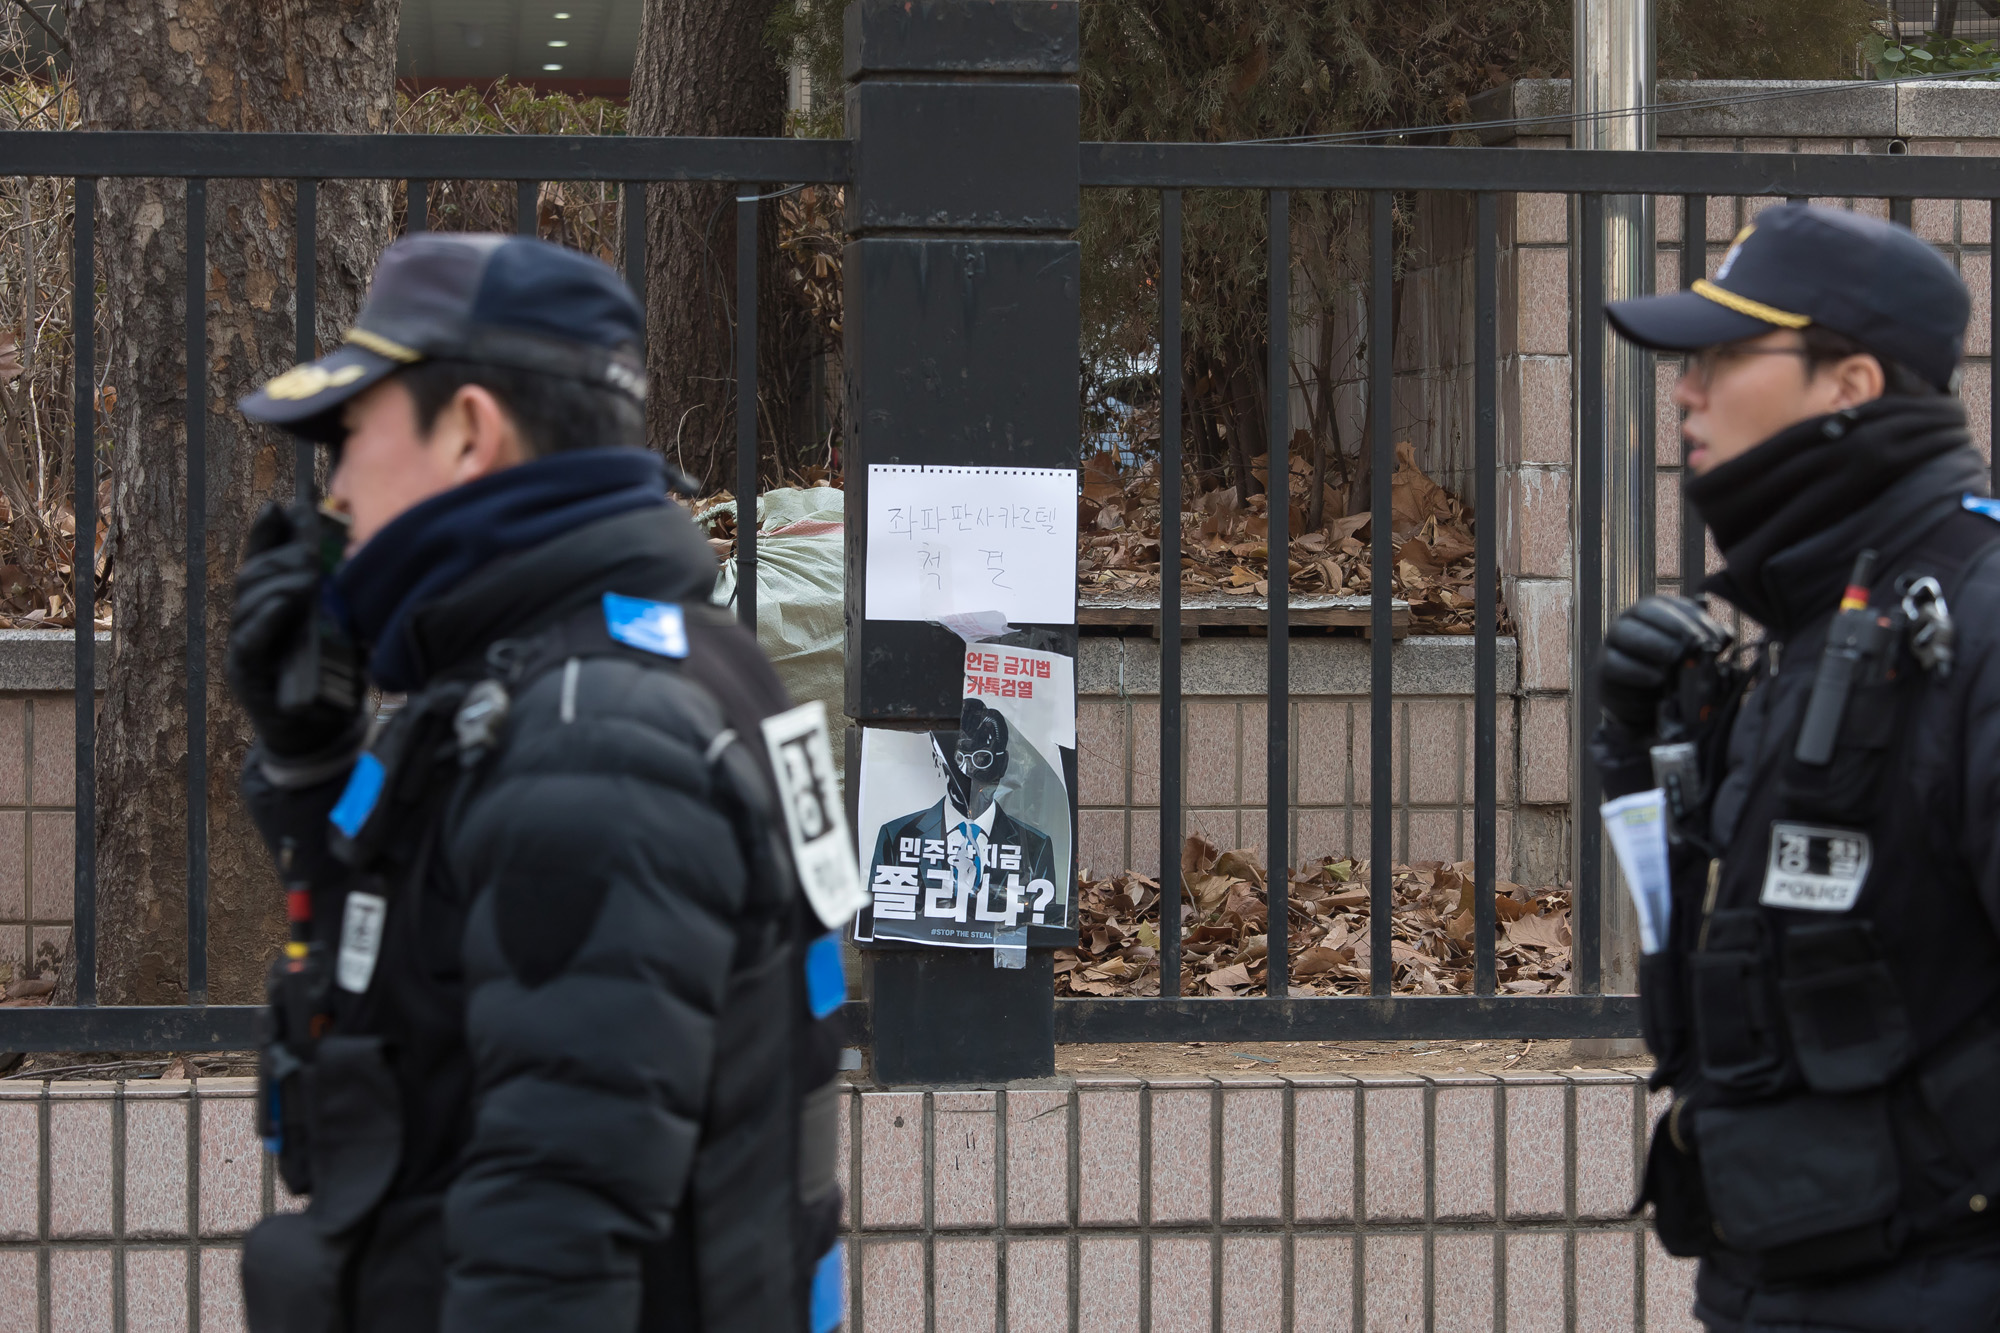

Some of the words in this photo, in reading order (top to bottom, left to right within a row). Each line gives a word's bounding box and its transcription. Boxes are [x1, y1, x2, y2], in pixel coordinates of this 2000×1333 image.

[966, 651, 999, 673] 언급
[1003, 655, 1051, 679] 금지법
[966, 674, 1033, 699] 카톡검열
[871, 865, 1055, 927] 쫄리냐?
[931, 928, 955, 936] #STOP
[971, 931, 993, 939] STEAL
